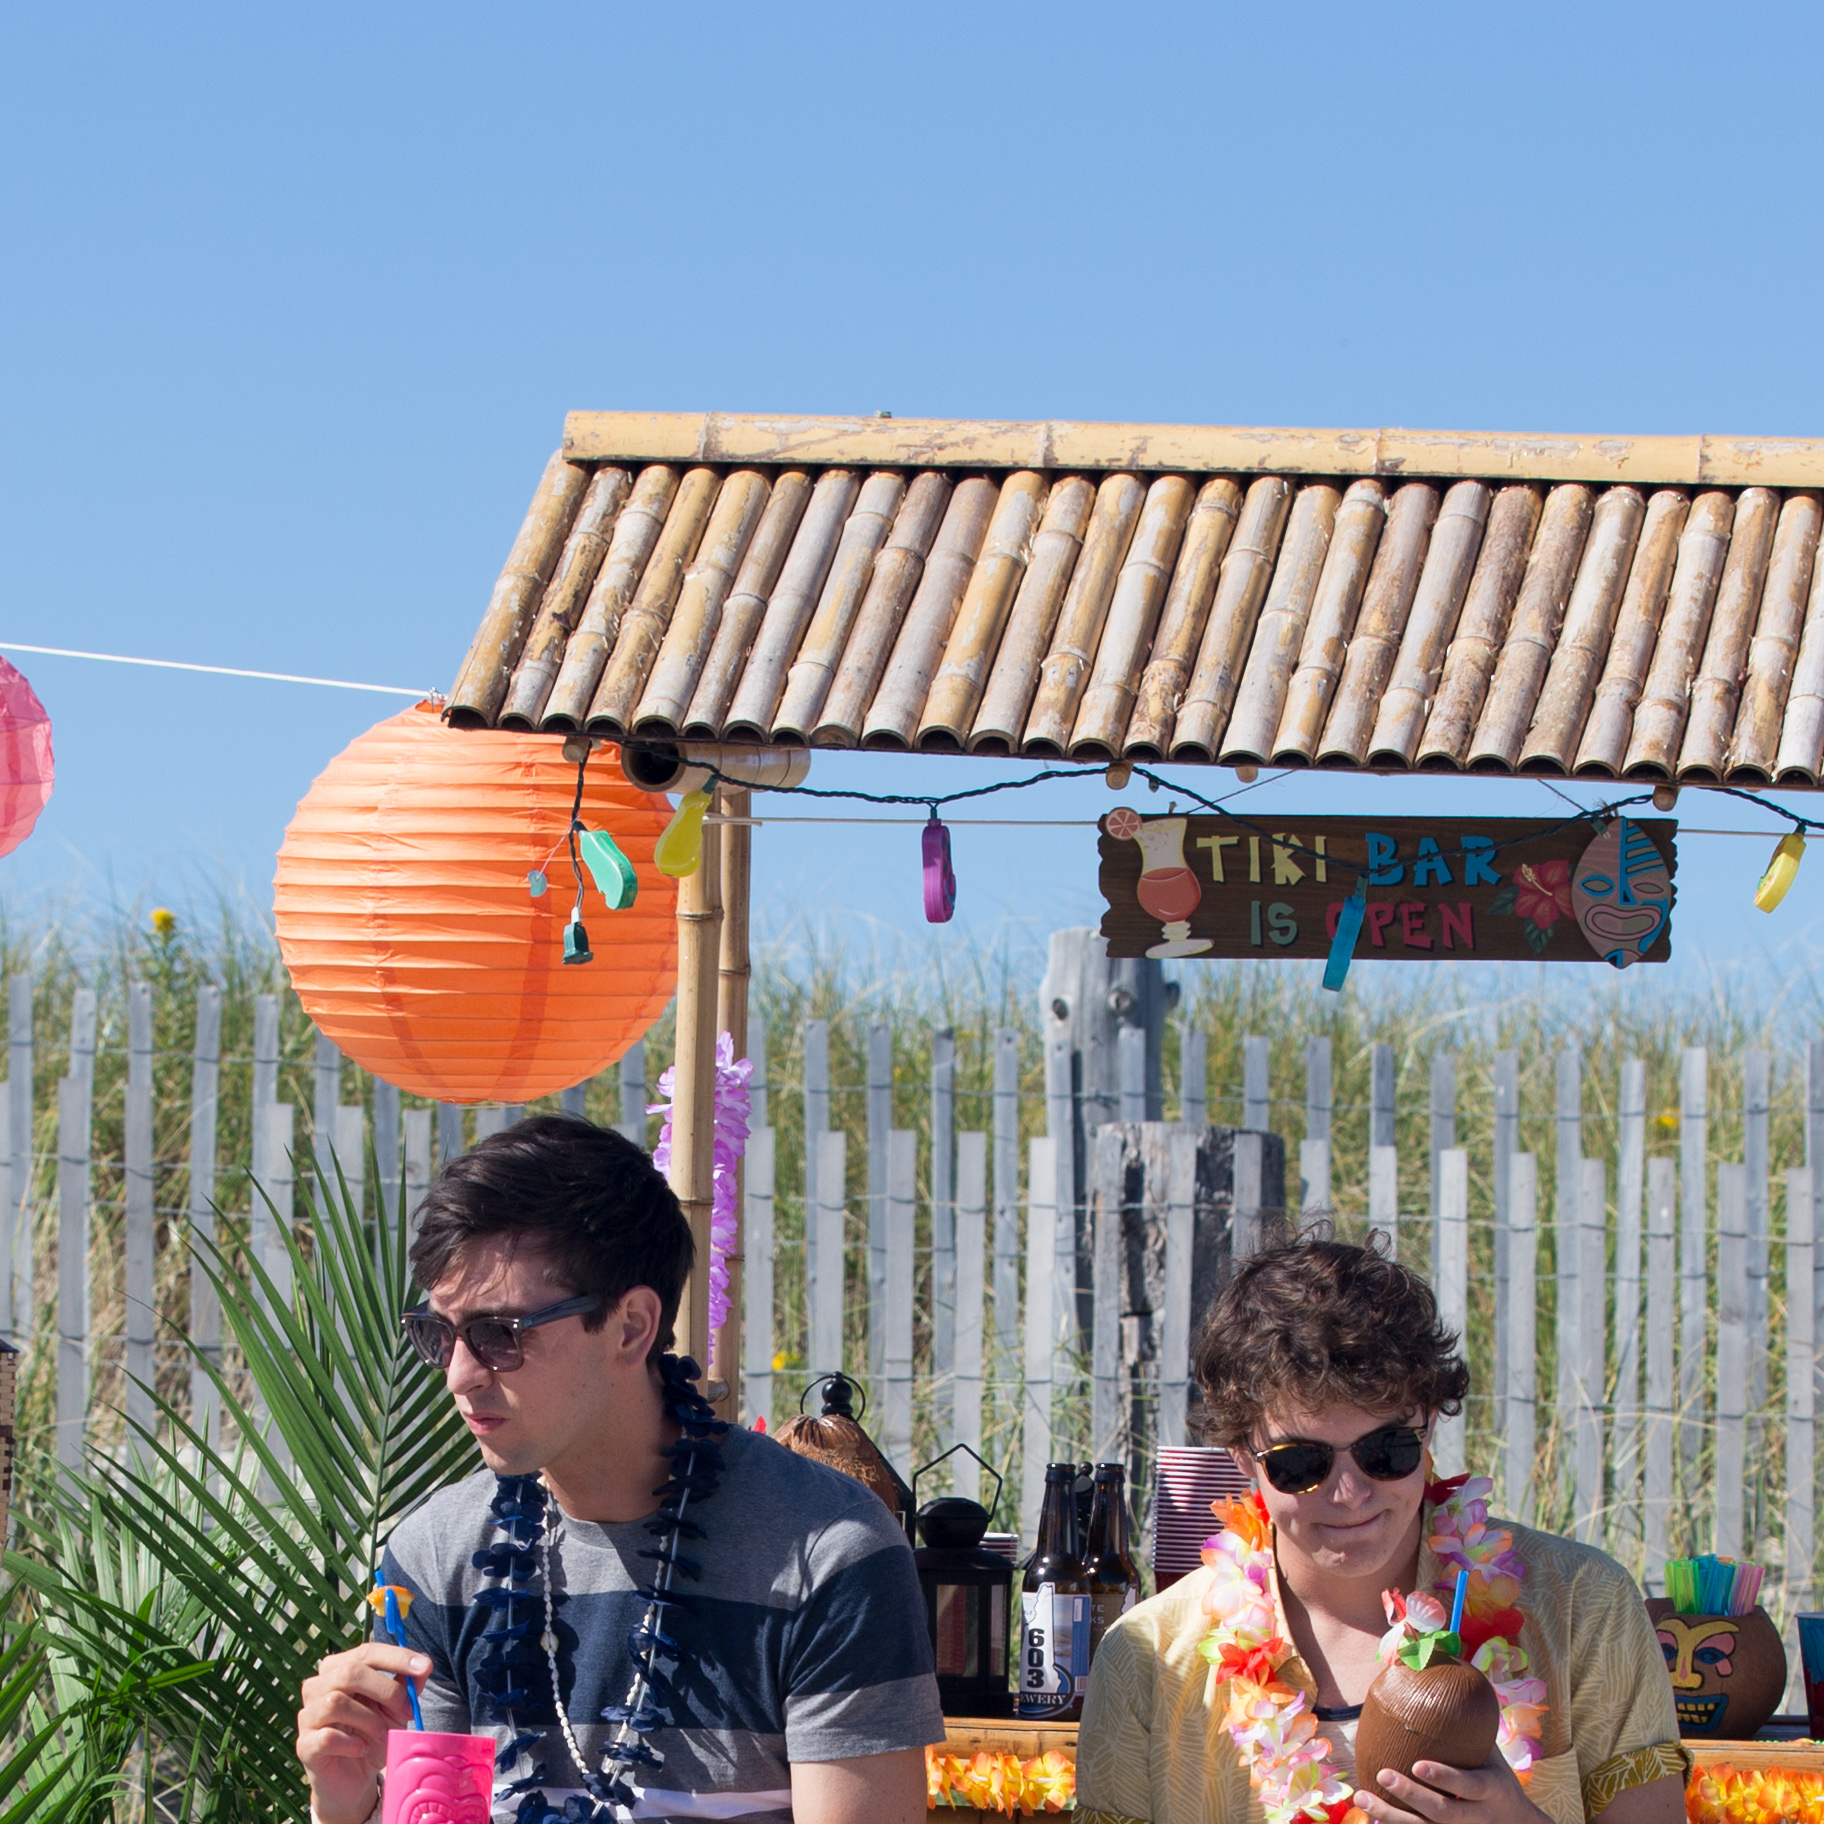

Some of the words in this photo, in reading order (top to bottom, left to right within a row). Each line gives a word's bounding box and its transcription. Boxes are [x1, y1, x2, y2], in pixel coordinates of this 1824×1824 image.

[1196, 833, 1327, 886] TIKI
[1365, 832, 1502, 886] BAR
[1250, 900, 1299, 947] IS
[1026, 1627, 1045, 1689] 603
